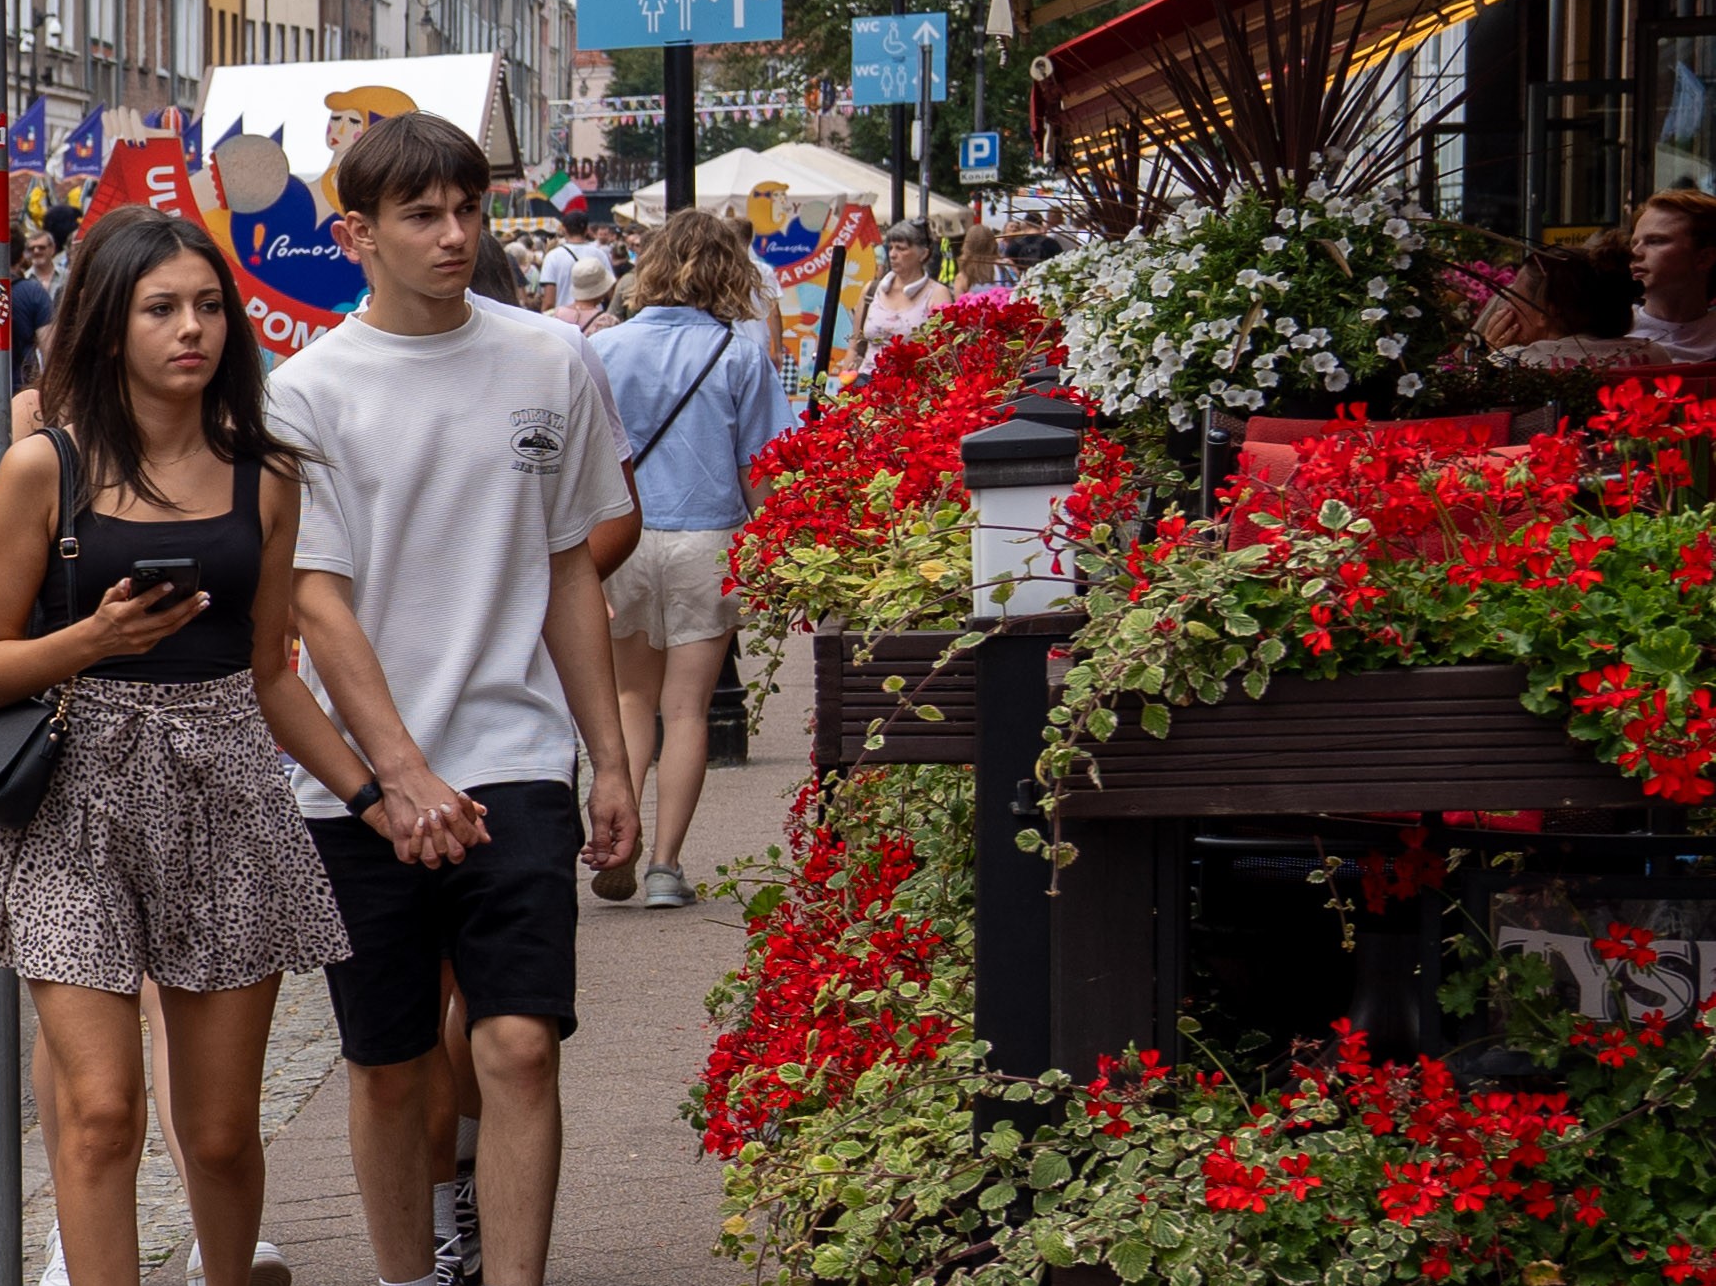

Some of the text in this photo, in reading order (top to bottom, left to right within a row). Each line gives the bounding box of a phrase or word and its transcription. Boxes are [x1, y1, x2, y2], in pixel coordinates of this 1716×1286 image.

[855, 21, 880, 33] WC
[855, 65, 880, 77] WC
[968, 137, 991, 166] P
[1497, 926, 1716, 1024] TYS
